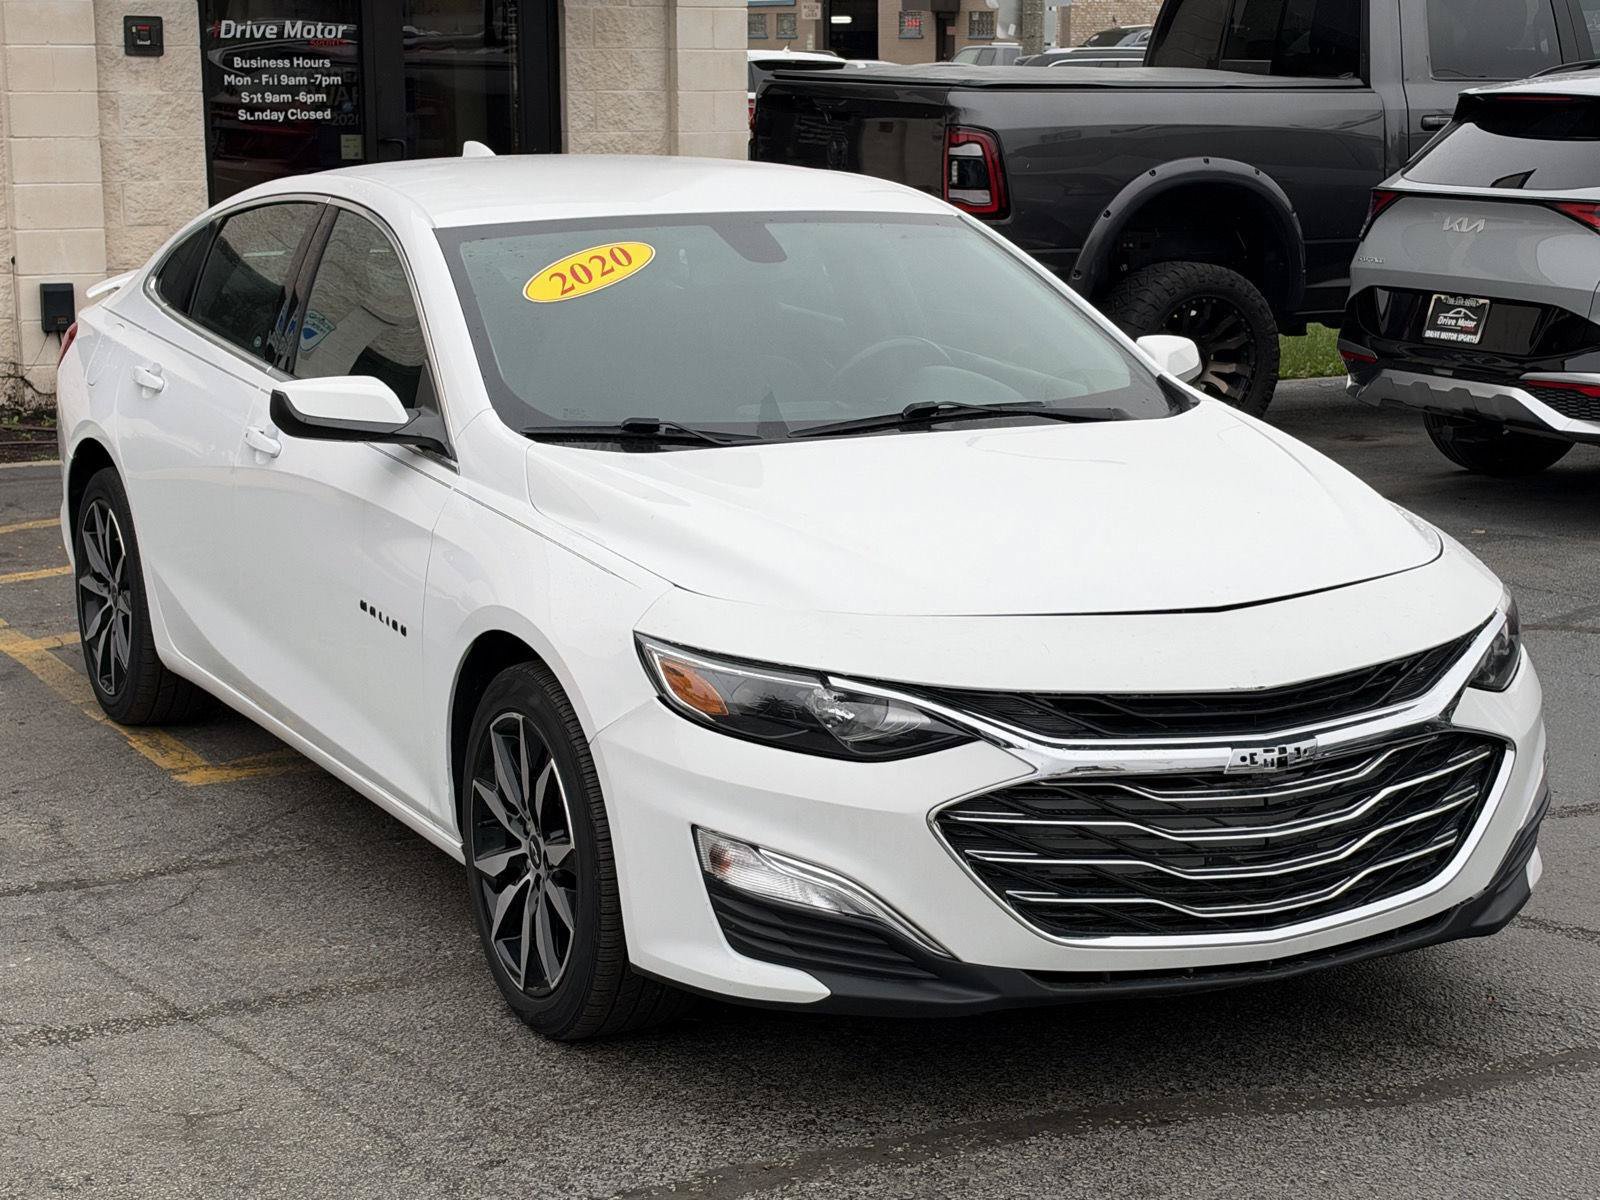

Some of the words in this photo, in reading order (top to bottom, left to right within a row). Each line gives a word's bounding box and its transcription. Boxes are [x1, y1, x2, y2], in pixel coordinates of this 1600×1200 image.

[283, 20, 348, 39] Motor
[233, 56, 291, 68] Business
[293, 56, 331, 68] Hours
[223, 74, 252, 86] Mon
[279, 74, 308, 86] 9am
[264, 92, 292, 103] 9am
[287, 108, 331, 120] Closed
[549, 246, 633, 295] 2020
